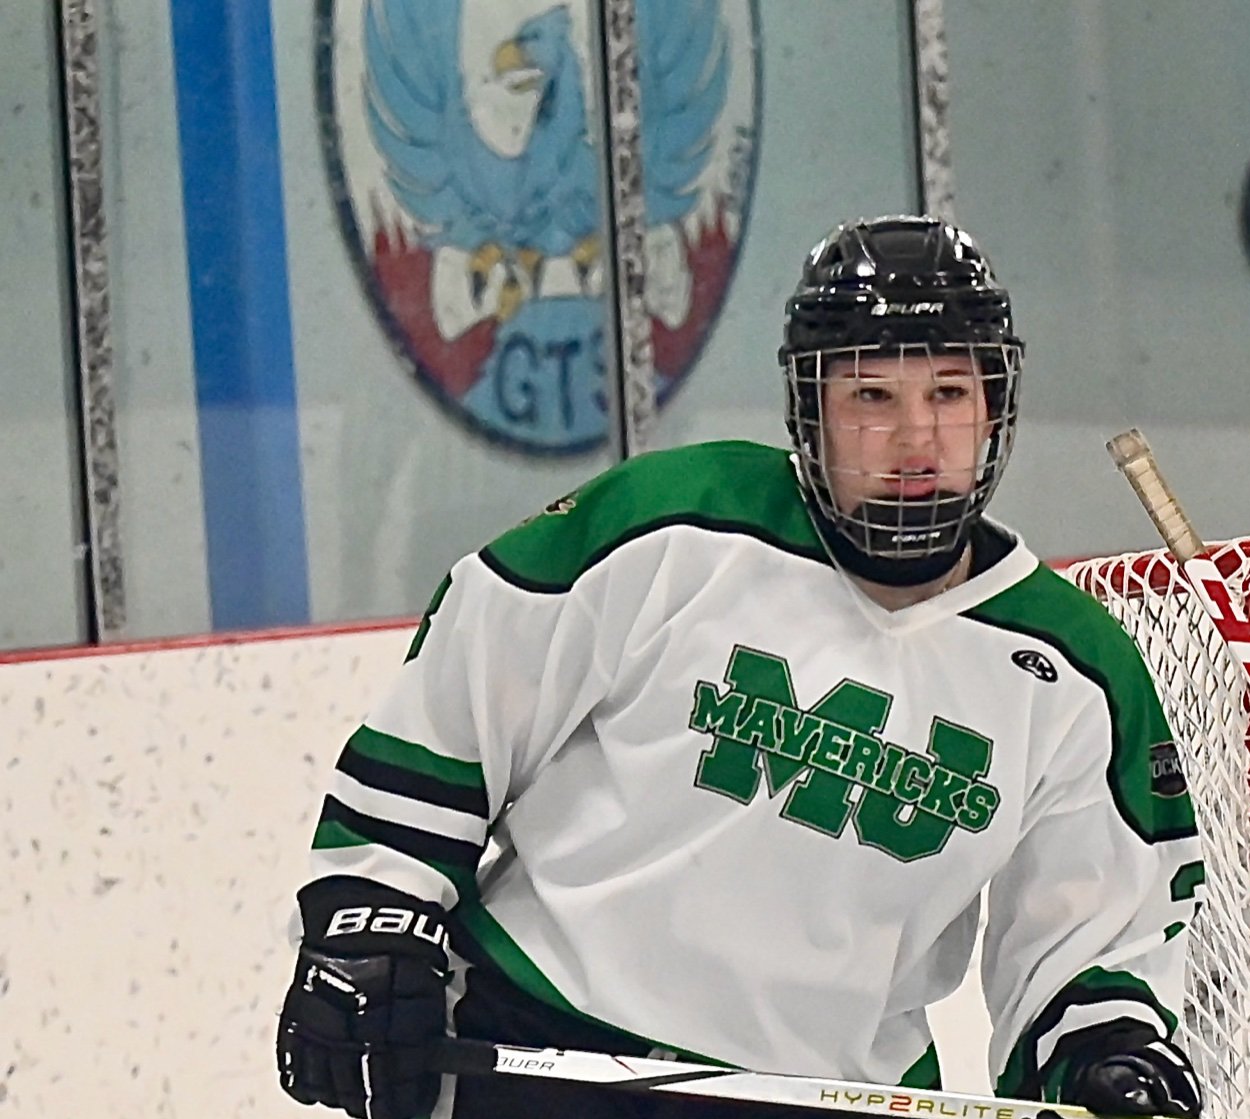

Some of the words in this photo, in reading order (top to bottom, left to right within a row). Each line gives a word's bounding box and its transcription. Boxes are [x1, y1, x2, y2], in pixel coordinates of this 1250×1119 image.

[689, 680, 1001, 834] MAVERICKS
[324, 907, 446, 947] BAU
[498, 1056, 555, 1071] AUER
